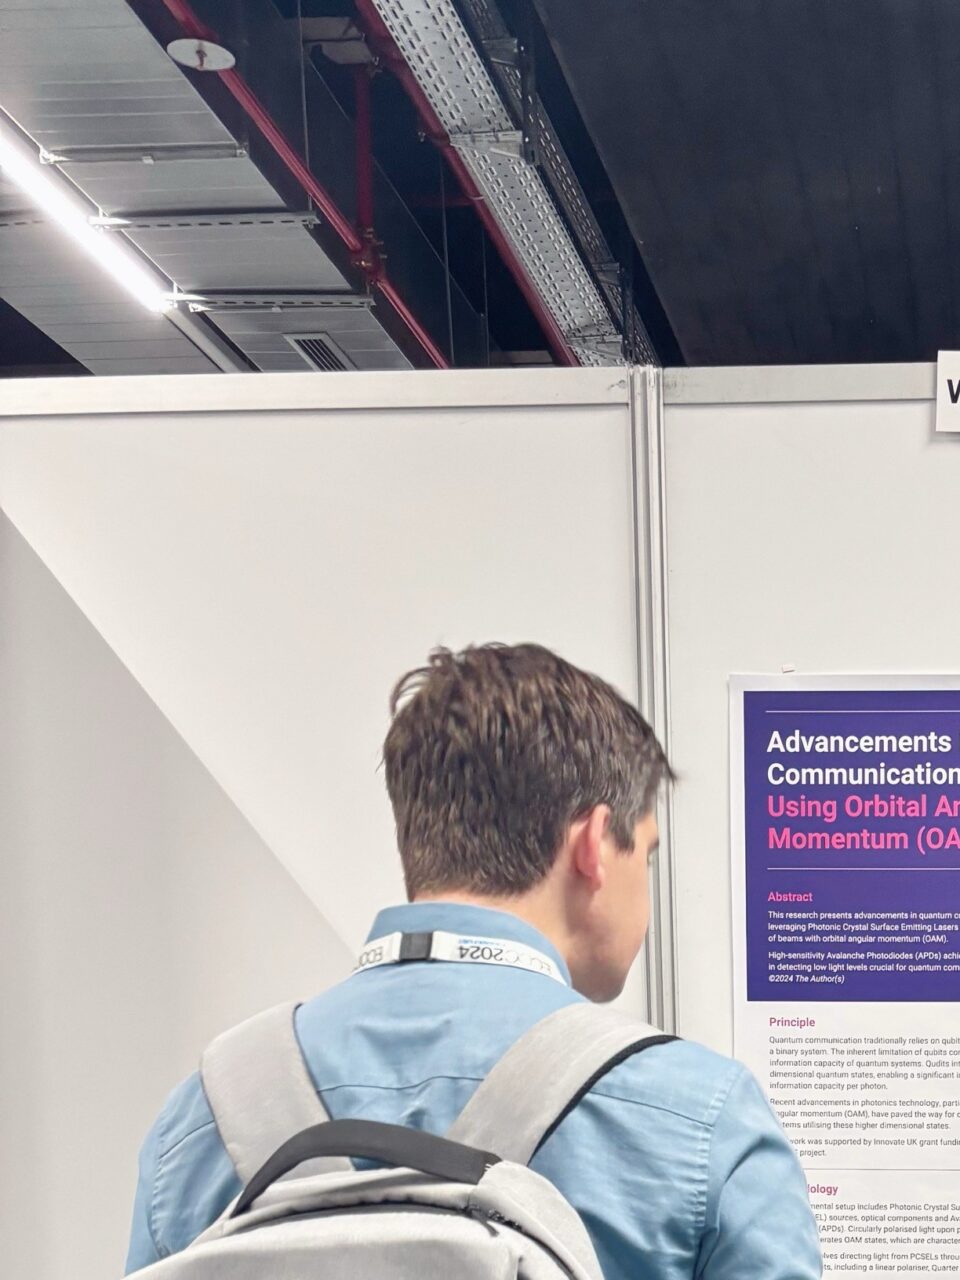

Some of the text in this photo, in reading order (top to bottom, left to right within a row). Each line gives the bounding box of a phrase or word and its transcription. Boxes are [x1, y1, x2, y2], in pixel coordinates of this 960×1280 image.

[767, 730, 952, 753] Advancements
[768, 795, 837, 823] Using
[844, 794, 927, 817] Orbital
[768, 827, 909, 849] Momentum
[768, 892, 813, 902] Abstract
[768, 911, 784, 919] This
[820, 912, 853, 920] presents
[918, 912, 953, 920] quantum
[768, 923, 807, 932] leveraging
[808, 923, 841, 931] Photonic
[842, 923, 869, 932] Crystal
[870, 923, 900, 931] Surface
[901, 923, 932, 932] Emitting
[768, 934, 776, 942] of
[822, 934, 847, 942] orbital
[848, 935, 876, 944] angular
[922, 934, 949, 944] (OAM).
[768, 952, 825, 960] High-sensitivity
[866, 952, 914, 960] Photodiodes
[915, 952, 942, 961] (APDs)
[777, 963, 812, 972] detecting
[828, 963, 845, 973] light
[895, 963, 907, 971] for
[908, 964, 942, 972] quantum
[810, 974, 845, 984] Author(s)
[769, 1017, 816, 1029] Principle
[769, 1036, 804, 1044] Quantum
[863, 1036, 907, 1046] traditionally
[775, 1048, 799, 1056] binary
[769, 1059, 812, 1067] information
[813, 1060, 845, 1068] capacity
[856, 1060, 889, 1068] quantum
[925, 1060, 950, 1068] Qudits
[769, 1070, 815, 1078] dimensional
[816, 1072, 849, 1080] quantum
[876, 1071, 909, 1080] enabling
[916, 1071, 955, 1080] significant
[769, 1081, 813, 1090] information
[813, 1083, 845, 1091] capacity
[860, 1082, 888, 1091] photon.
[847, 1225, 882, 1234] Circularly
[883, 1226, 918, 1234] polarised
[919, 1226, 935, 1235] light
